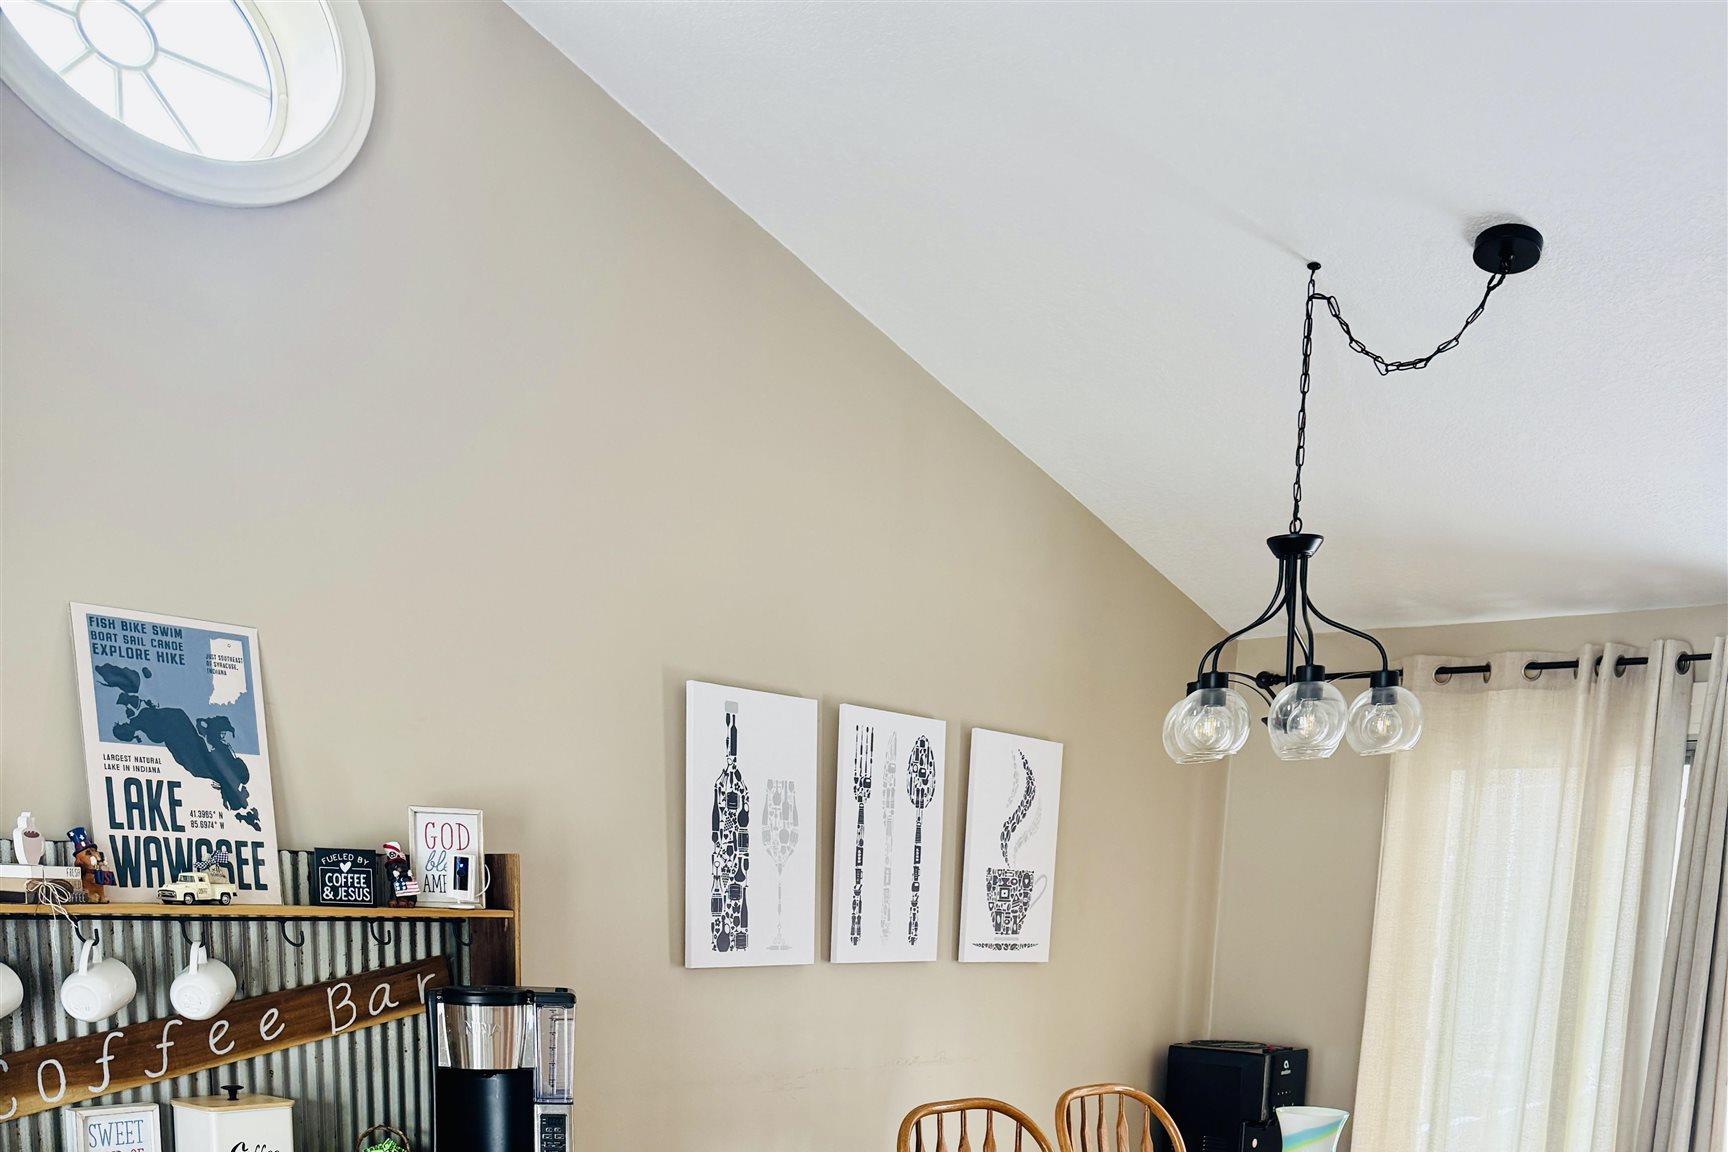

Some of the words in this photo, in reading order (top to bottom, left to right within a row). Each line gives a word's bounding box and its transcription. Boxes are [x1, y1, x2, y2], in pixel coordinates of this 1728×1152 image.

[88, 616, 116, 631] FISH
[121, 620, 147, 634] BIKE
[152, 625, 183, 639] SWIM
[90, 630, 118, 643] BOAT
[123, 634, 146, 647] SAIL
[150, 638, 184, 651] CANOE
[92, 644, 151, 661] EXPLORE
[156, 653, 186, 666] HIKE
[102, 753, 131, 762] LARGEST
[133, 756, 162, 765] NATURAL
[103, 763, 120, 771] LAKE
[132, 765, 161, 774] INDIANA
[105, 776, 185, 833] LAKE
[424, 821, 470, 851] GOD
[321, 853, 354, 865] FUELED
[357, 854, 370, 866] BY
[325, 873, 367, 888] COFFEE
[322, 887, 335, 900] &
[335, 887, 371, 902] JESUS
[325, 972, 436, 1036] Bar
[88, 1119, 144, 1148] SWEET
